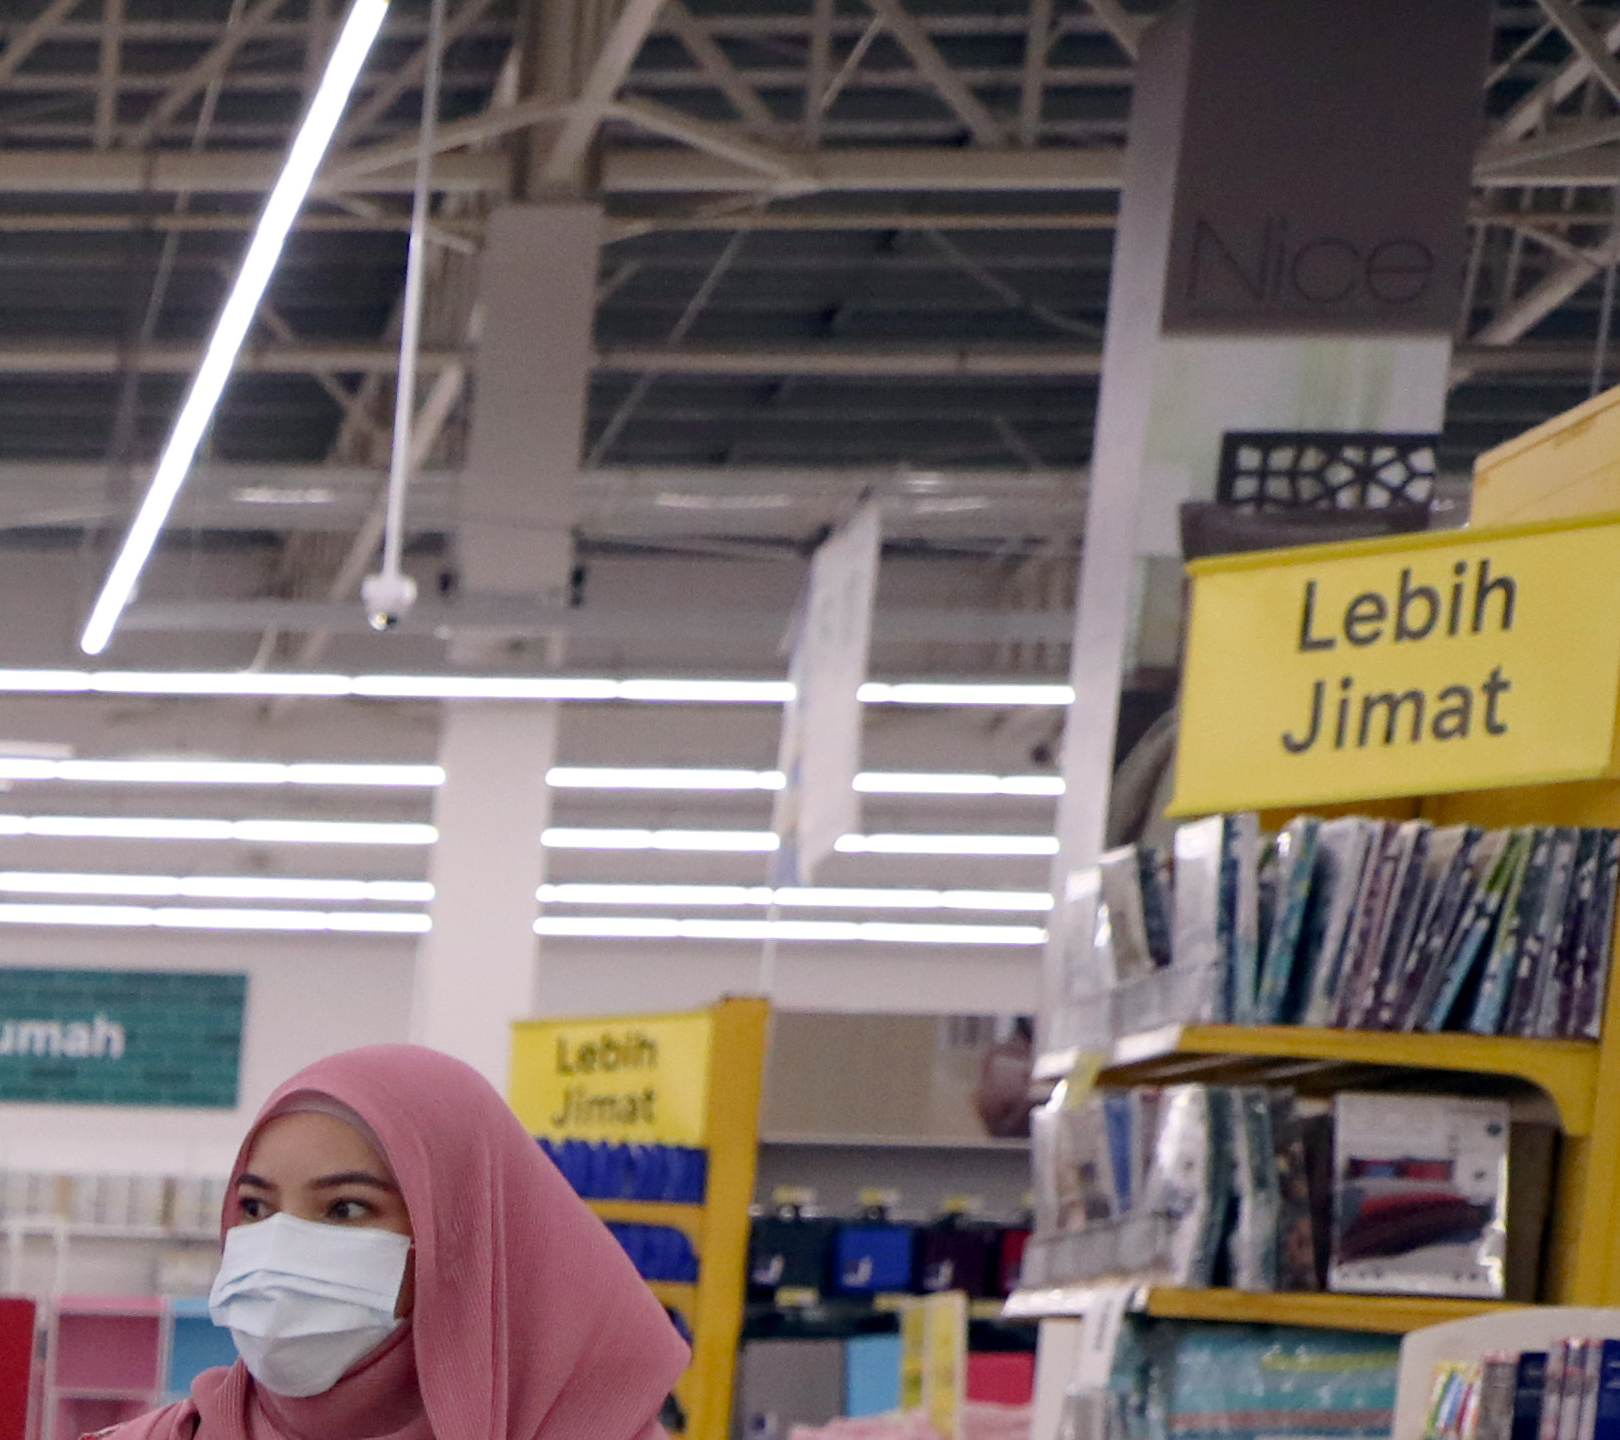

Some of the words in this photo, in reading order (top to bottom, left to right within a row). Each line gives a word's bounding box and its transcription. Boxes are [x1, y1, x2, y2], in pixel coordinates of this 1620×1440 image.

[1185, 215, 1436, 306] Nice
[1297, 558, 1519, 653] Lebih
[1281, 665, 1513, 757] Jimat
